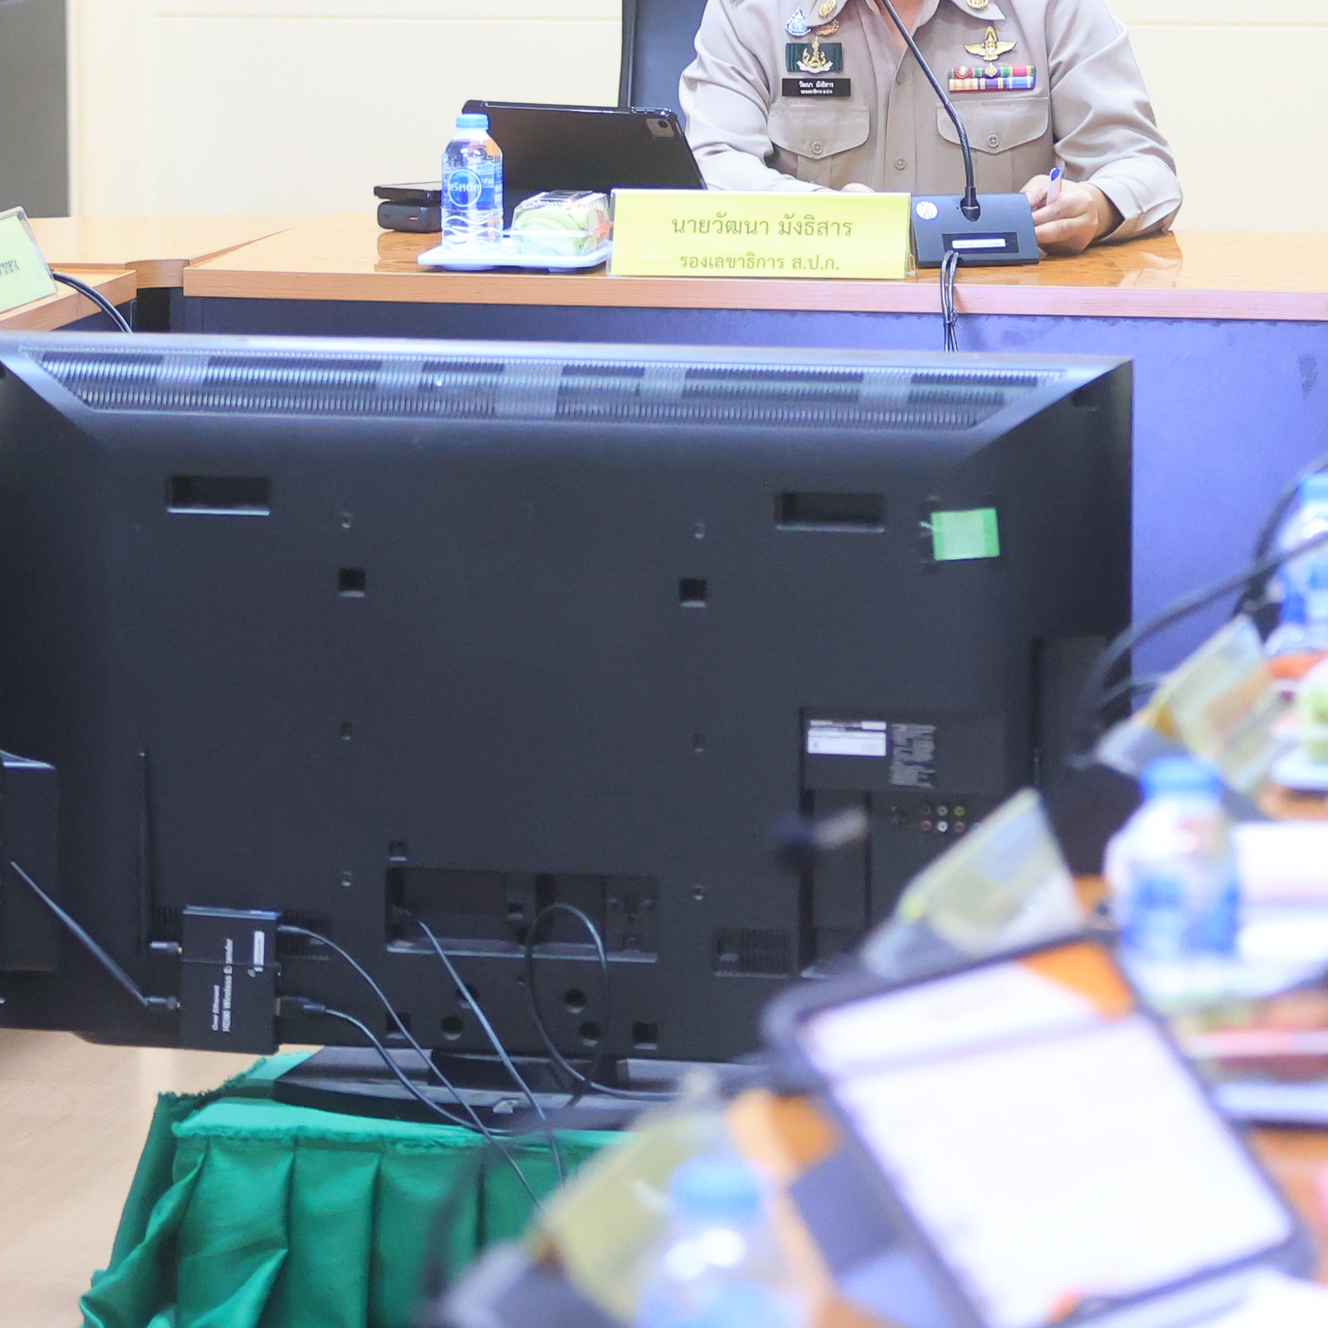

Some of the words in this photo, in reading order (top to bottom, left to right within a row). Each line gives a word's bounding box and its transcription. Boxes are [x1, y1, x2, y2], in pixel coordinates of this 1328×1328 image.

[671, 211, 769, 236] นายวัฒนา
[778, 213, 853, 238] มังธิสาร
[680, 254, 785, 271] รองเลขาธิการ
[791, 255, 840, 271] ส.ป.ก.
